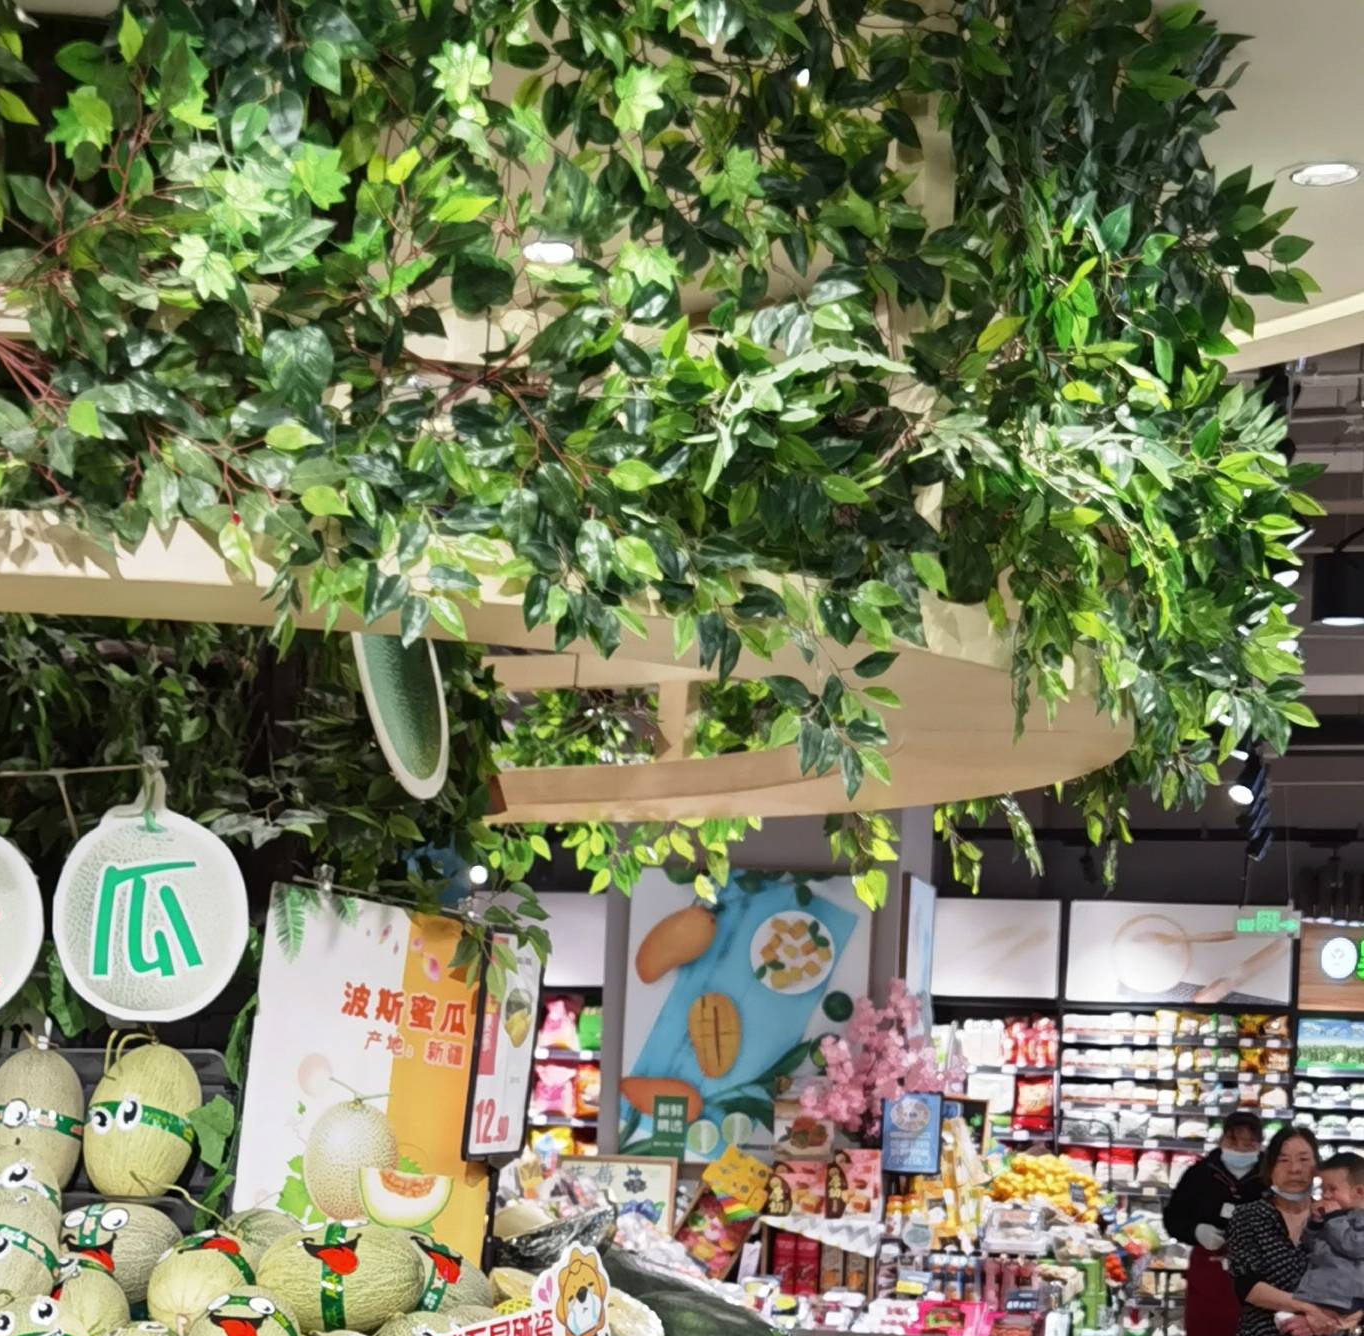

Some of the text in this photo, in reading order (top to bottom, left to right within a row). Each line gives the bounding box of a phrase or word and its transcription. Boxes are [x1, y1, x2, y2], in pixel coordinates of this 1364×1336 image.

[92, 860, 204, 978] 瓜
[340, 981, 468, 1037] 波斯蜜瓜
